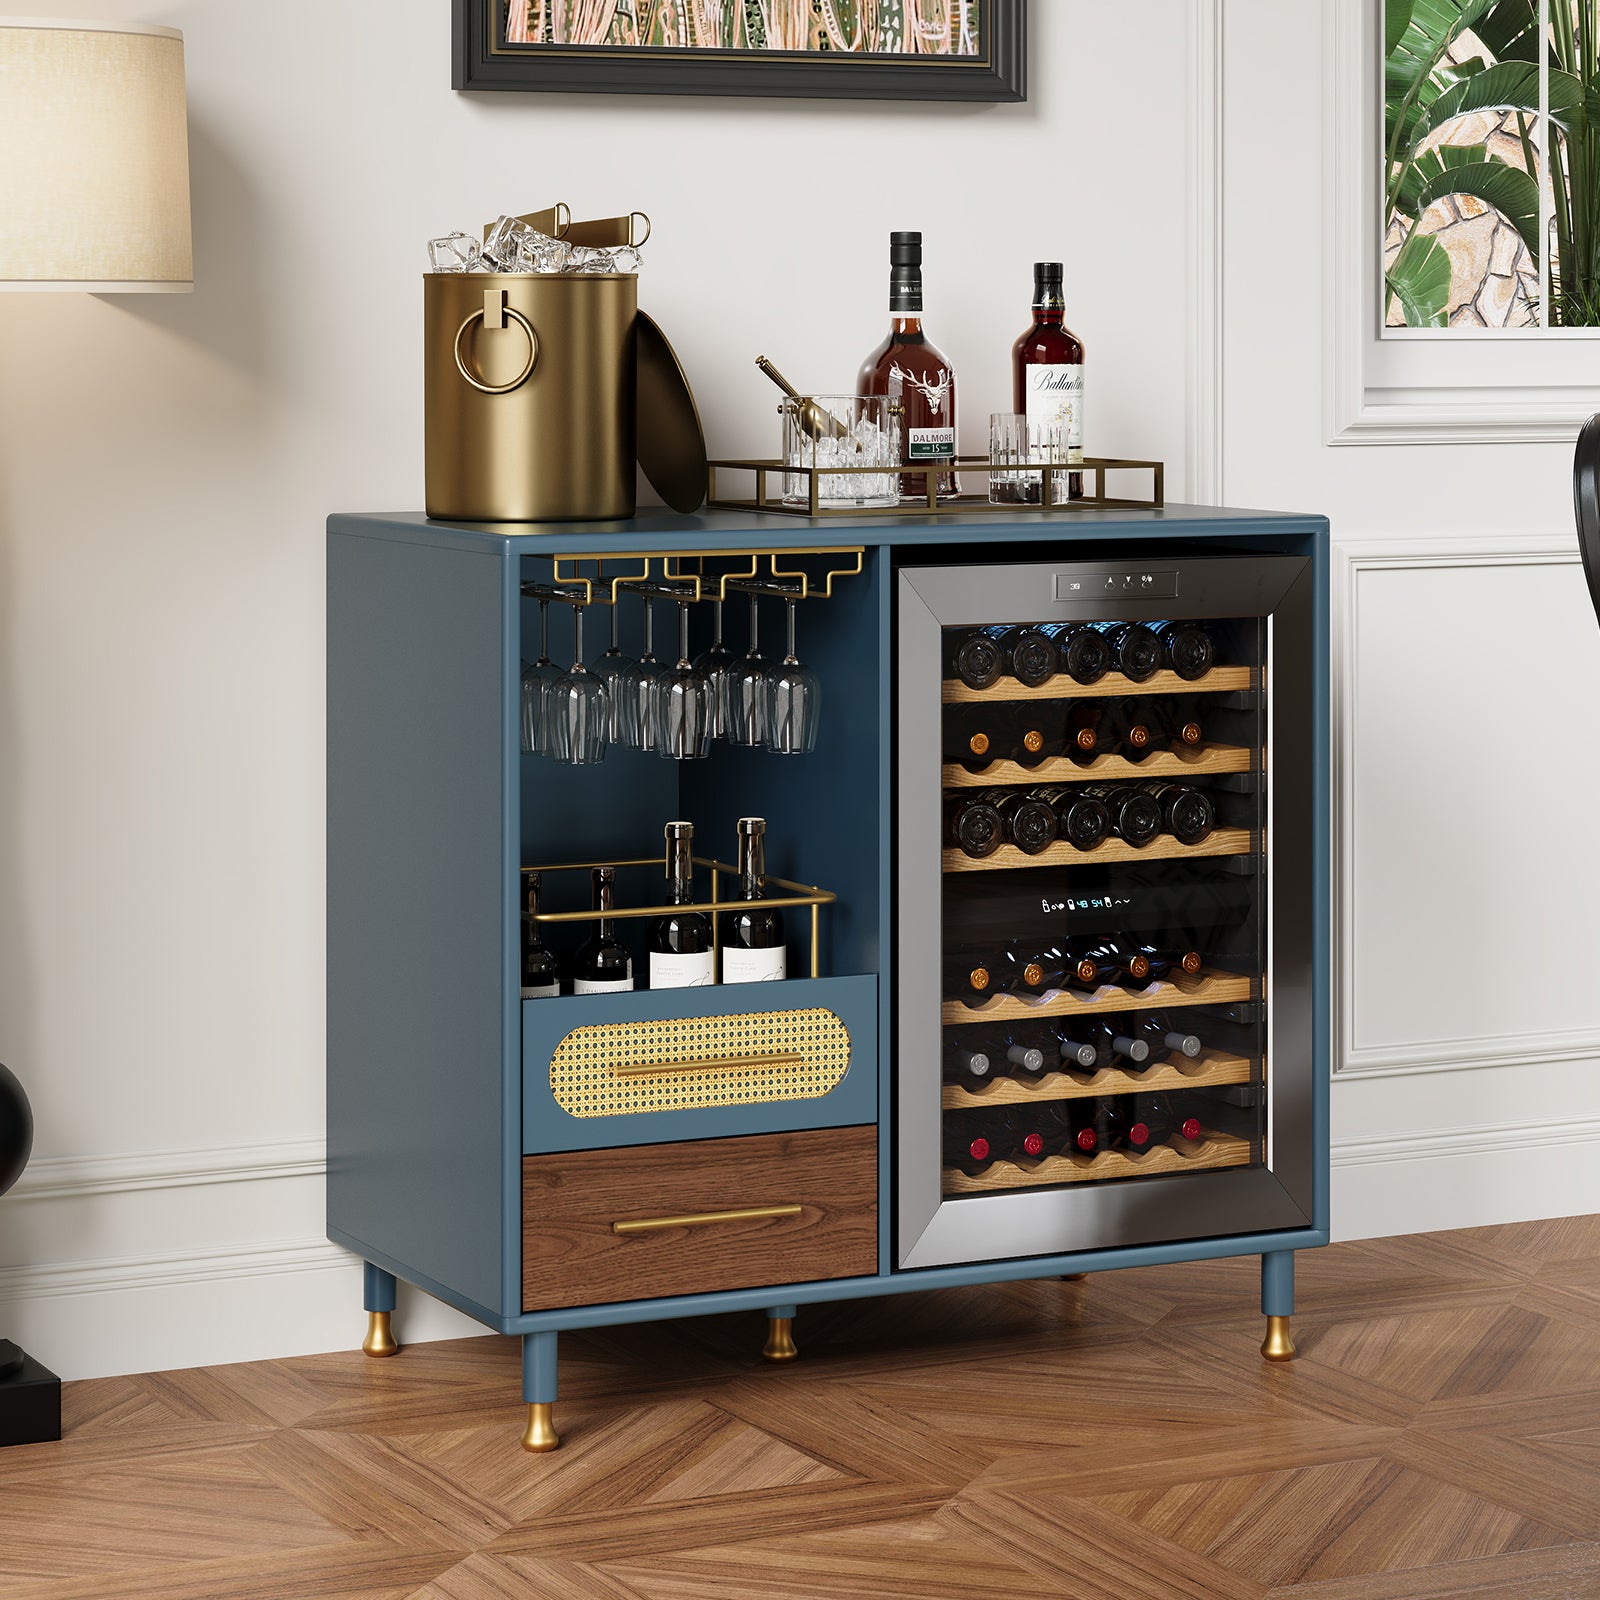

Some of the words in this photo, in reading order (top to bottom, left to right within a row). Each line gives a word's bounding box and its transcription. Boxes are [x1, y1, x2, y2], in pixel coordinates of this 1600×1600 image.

[912, 434, 952, 442] DALMORE
[932, 443, 940, 453] 15
[1091, 899, 1103, 908] 54
